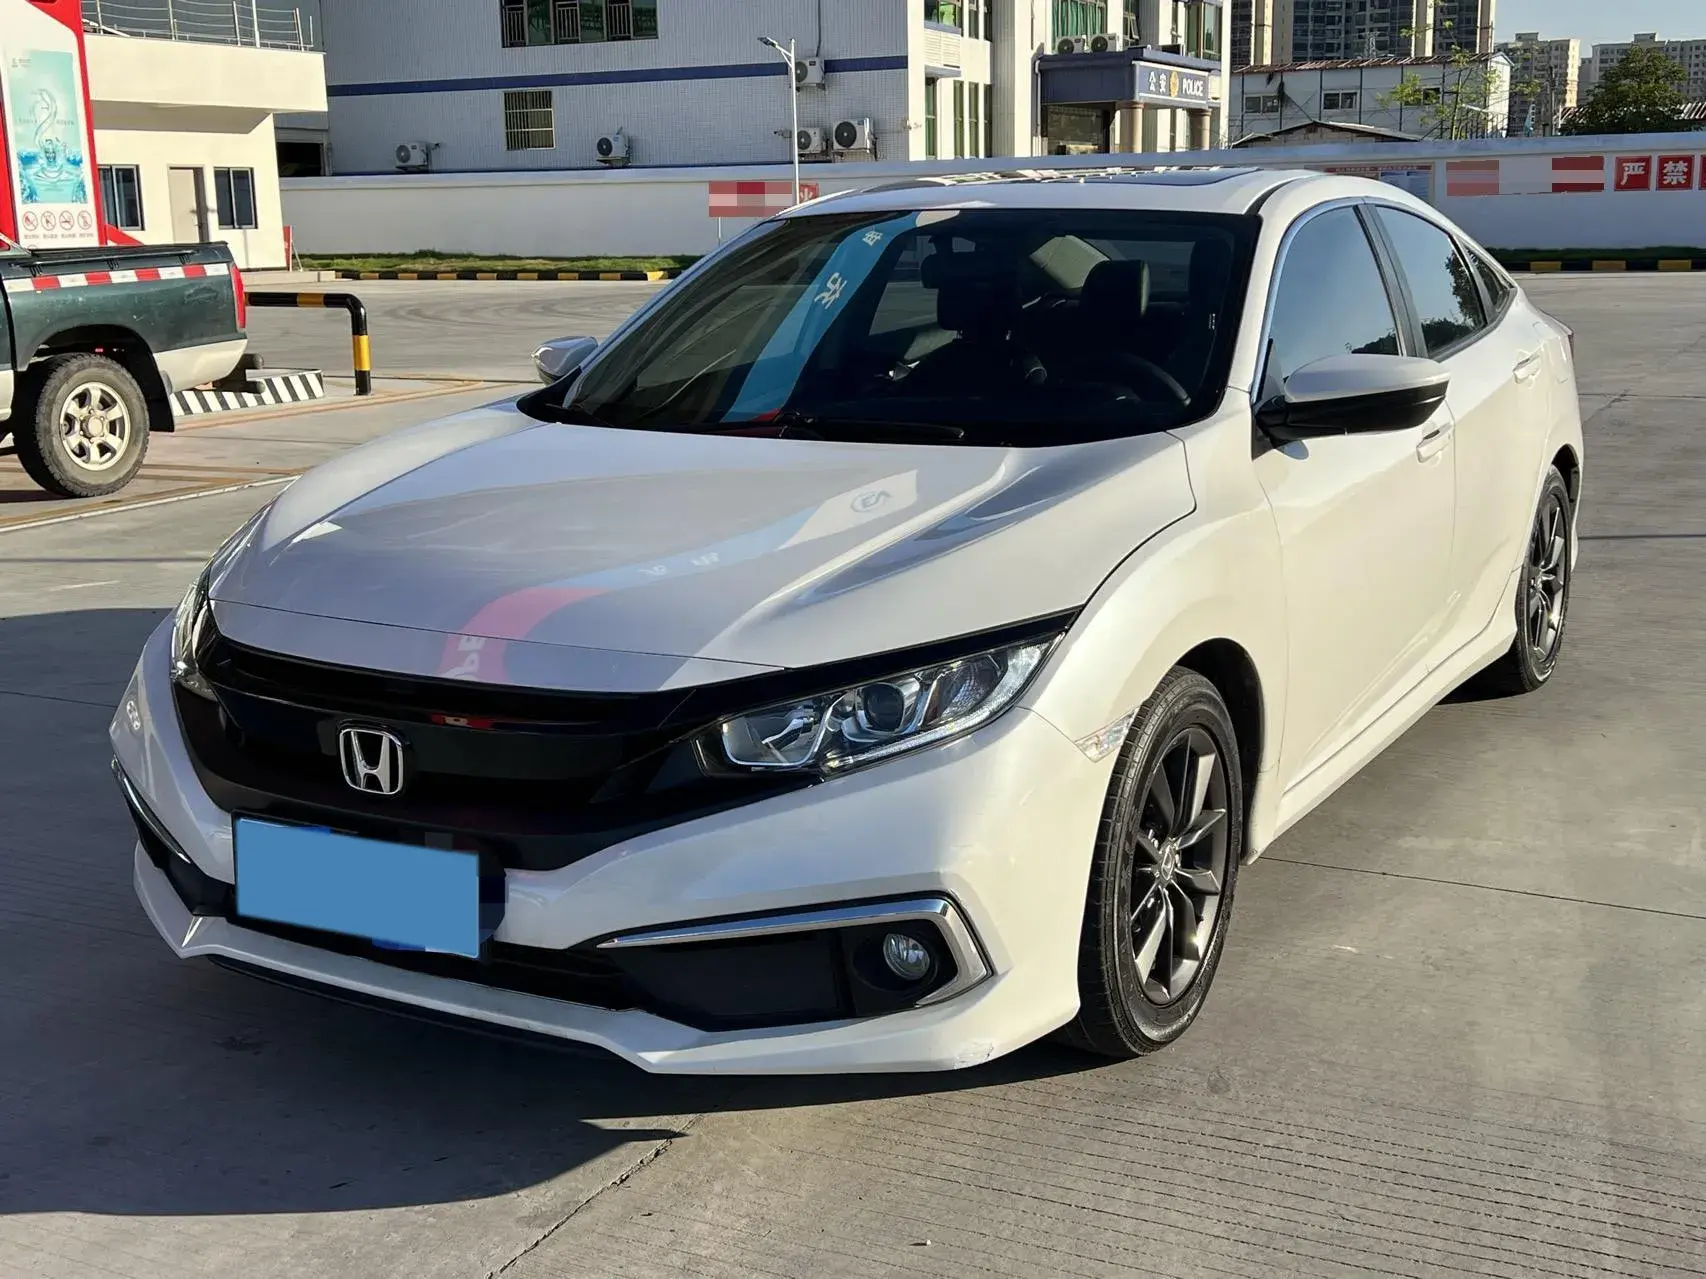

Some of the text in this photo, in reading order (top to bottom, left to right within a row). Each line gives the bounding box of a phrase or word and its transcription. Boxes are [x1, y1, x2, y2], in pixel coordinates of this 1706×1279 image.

[1149, 71, 1167, 94] 公安
[1182, 77, 1204, 97] POLICE
[1620, 160, 1688, 185] 严禁
